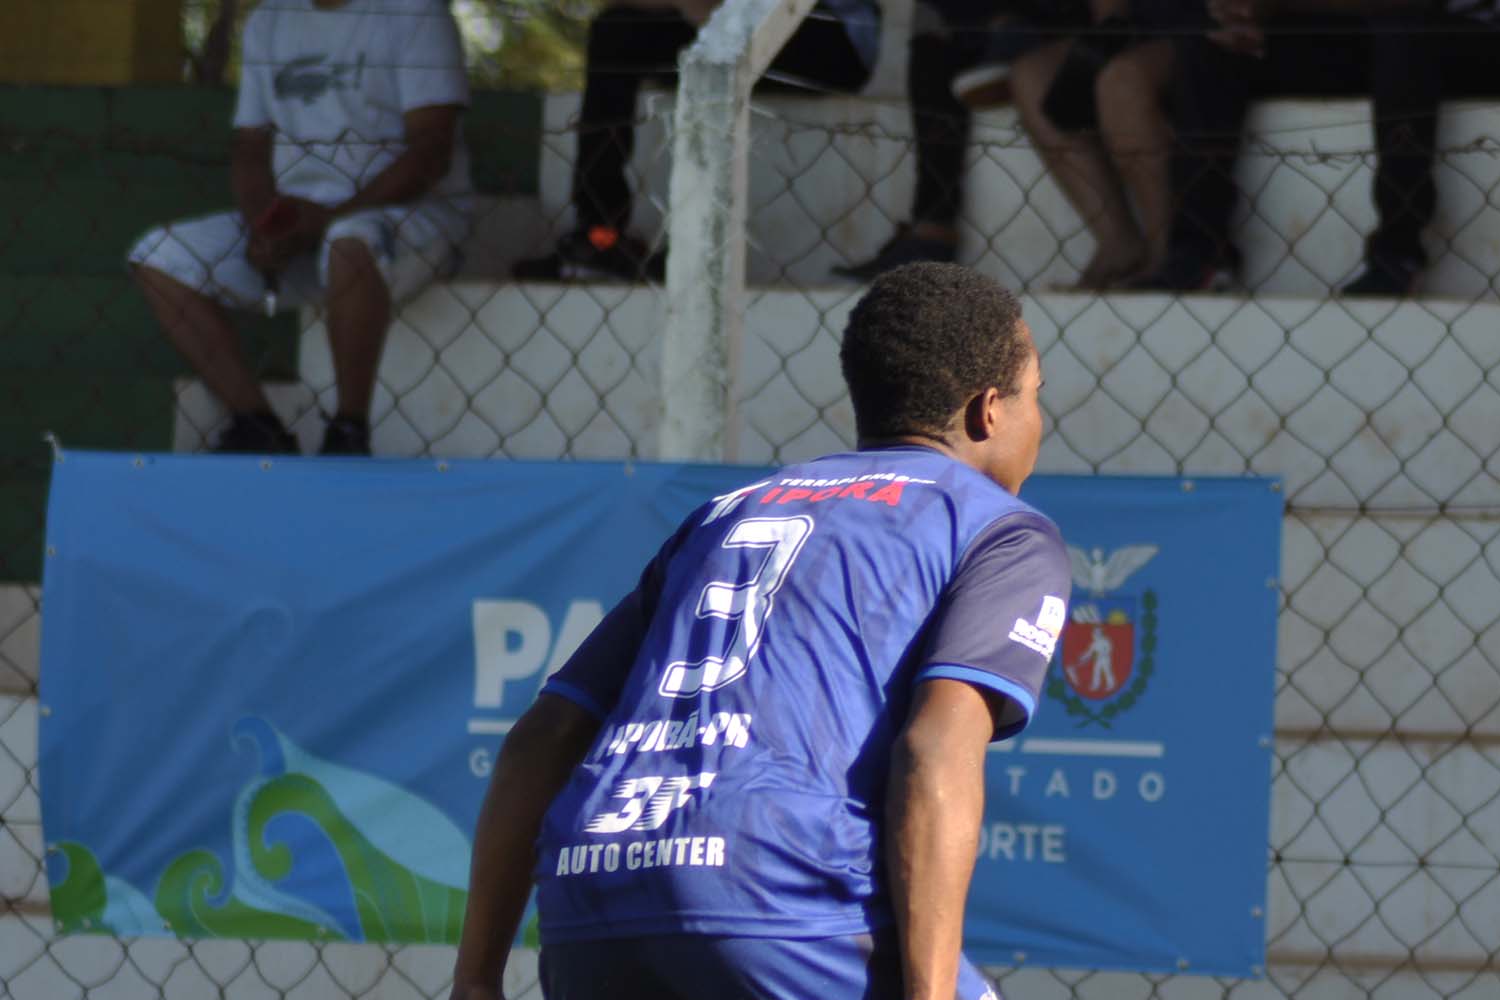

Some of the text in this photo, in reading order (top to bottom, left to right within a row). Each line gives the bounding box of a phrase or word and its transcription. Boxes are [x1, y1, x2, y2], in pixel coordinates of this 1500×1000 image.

[659, 514, 814, 700] 3
[556, 836, 726, 877] AUTO CENTER
